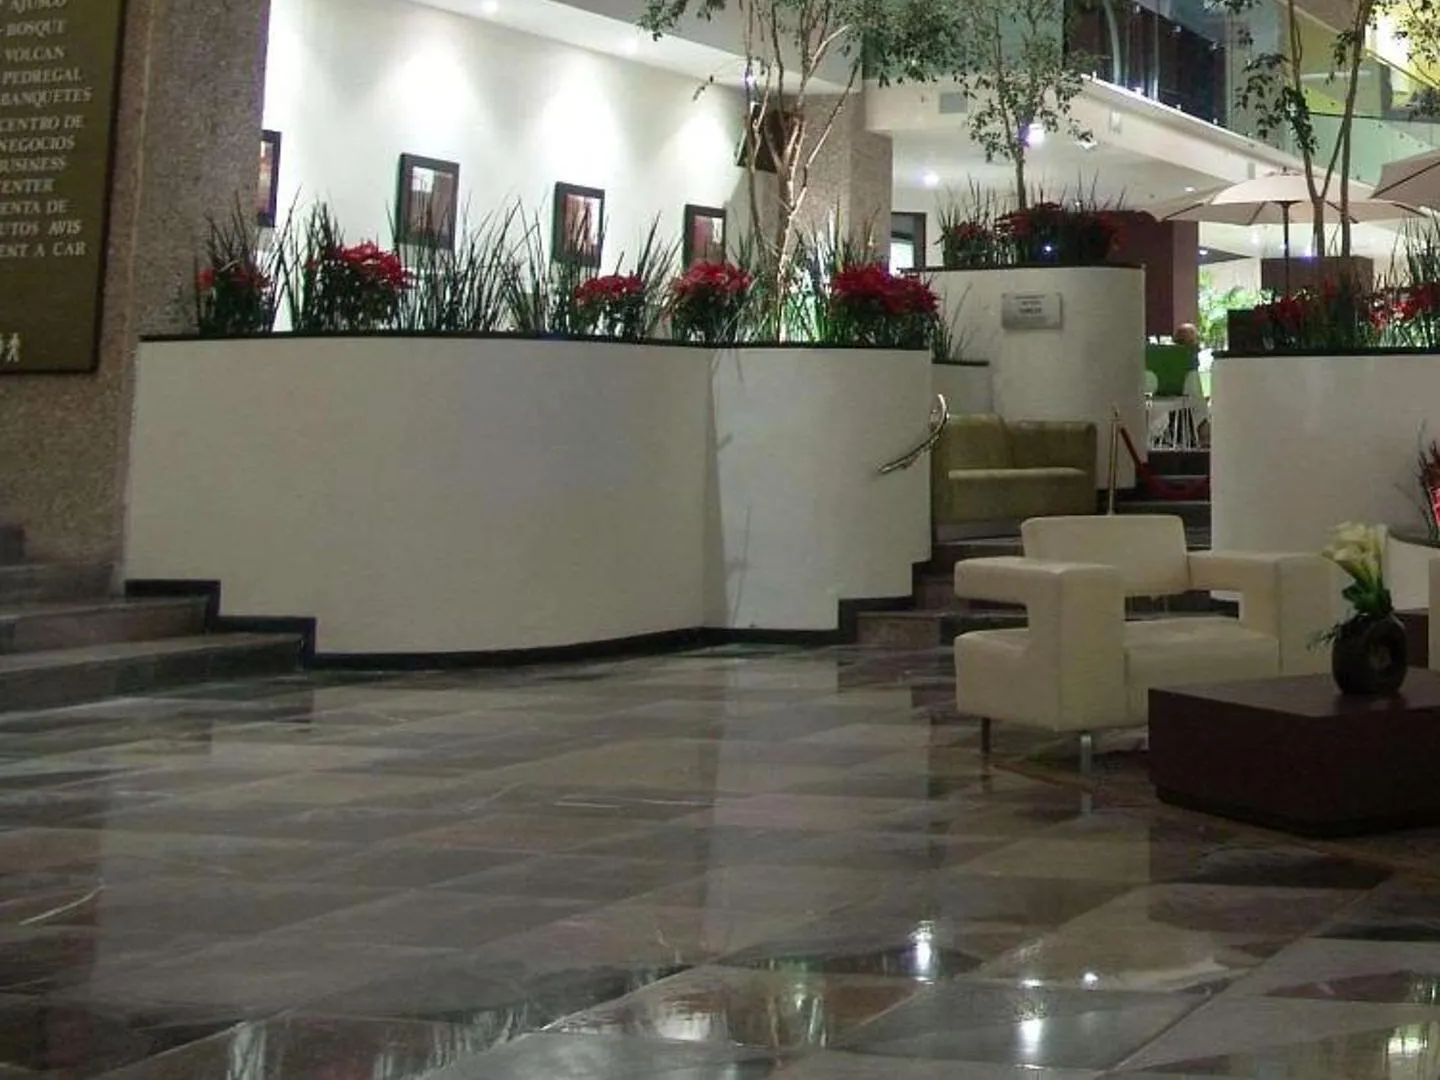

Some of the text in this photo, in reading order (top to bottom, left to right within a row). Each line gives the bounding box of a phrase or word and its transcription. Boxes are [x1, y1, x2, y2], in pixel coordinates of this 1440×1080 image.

[4, 45, 66, 62] VOLCAN
[2, 66, 81, 84] PEDREGAL
[0, 87, 93, 108] BANQUETES
[64, 114, 85, 129] DE
[0, 178, 56, 194] ENTER
[0, 199, 69, 215] ENTA DE
[48, 219, 83, 236] AVIS
[0, 240, 86, 257] ENT A CAR
